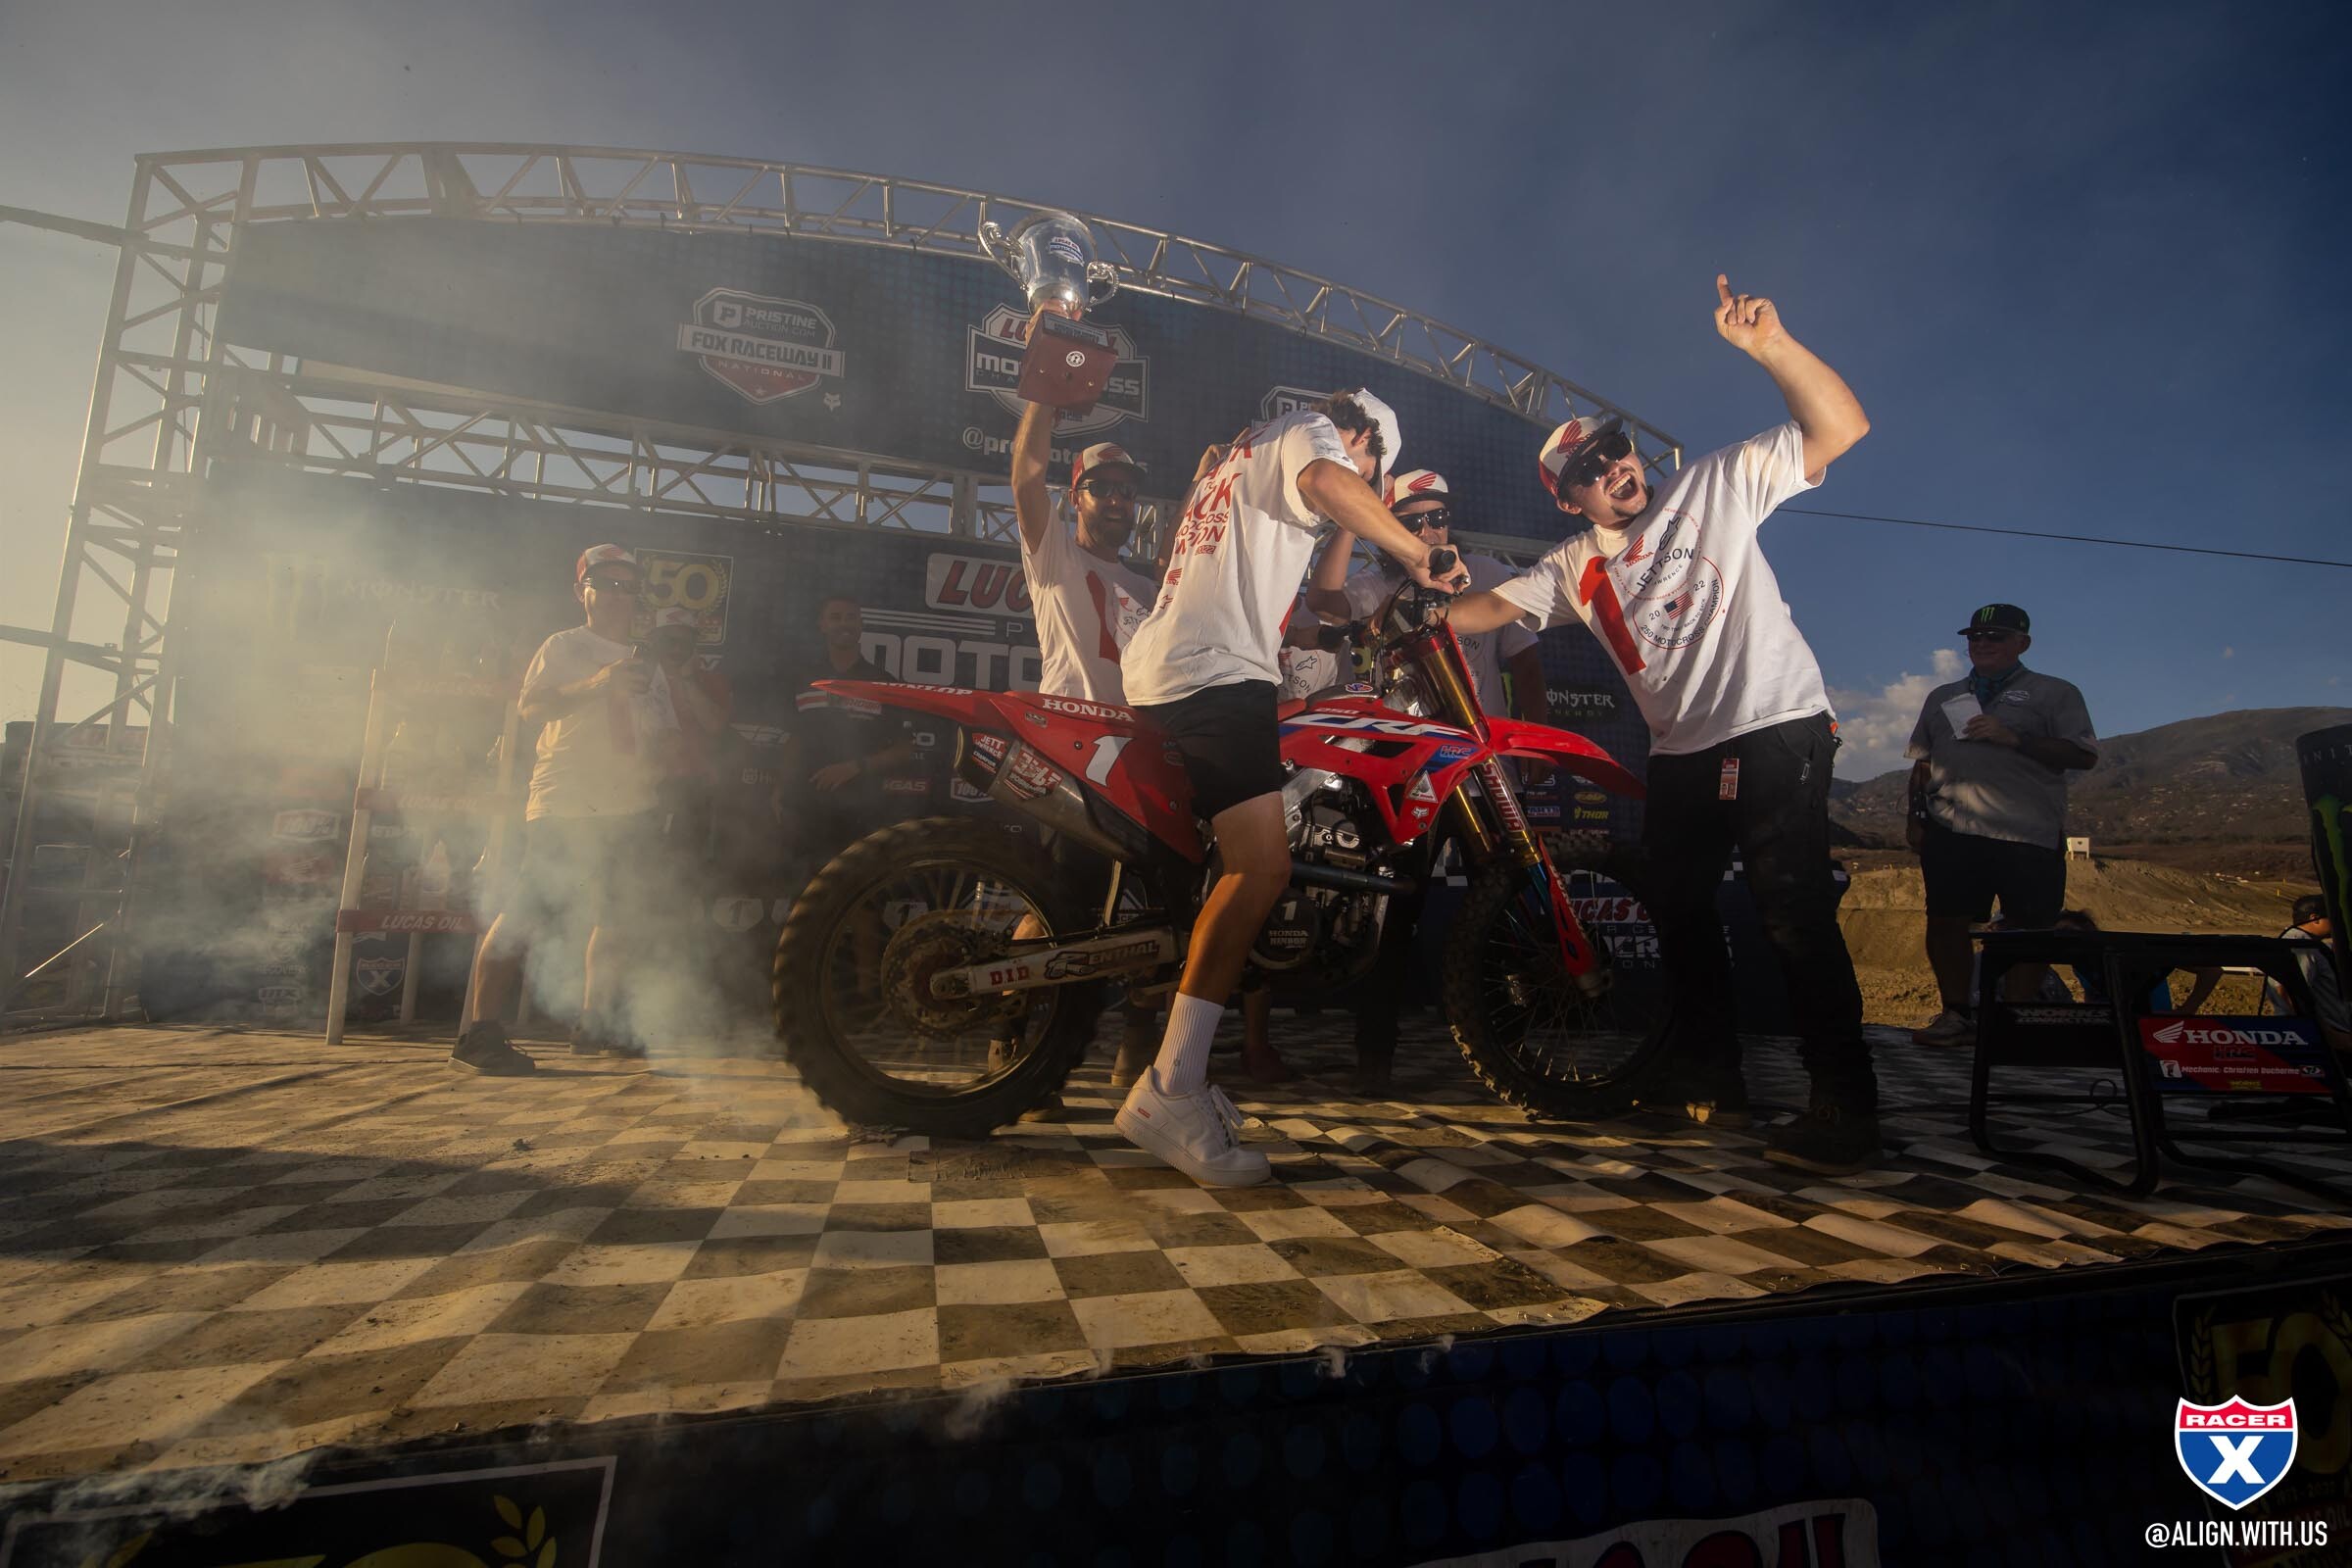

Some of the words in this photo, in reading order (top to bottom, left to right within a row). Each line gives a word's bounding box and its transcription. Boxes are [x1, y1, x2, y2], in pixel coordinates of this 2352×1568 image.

[745, 306, 818, 330] PRISTINE
[691, 330, 728, 354] FOX
[729, 337, 819, 368] RACEWAY
[717, 359, 807, 382] NATIONAL
[1625, 551, 1655, 568] HONDA
[1637, 547, 1694, 593] JETTSON
[645, 560, 724, 612] 50
[1692, 579, 1707, 592] 22
[1648, 609, 1662, 621] 20
[1545, 688, 1616, 709] ONSTER
[1042, 697, 1136, 723] HONDA
[980, 734, 1005, 750] JETT
[1085, 735, 1134, 788] 1
[1281, 900, 1298, 921] 1
[380, 914, 433, 931] LUCAS
[1044, 940, 1160, 979] RENTHAL
[2185, 1030, 2309, 1046] HONDA
